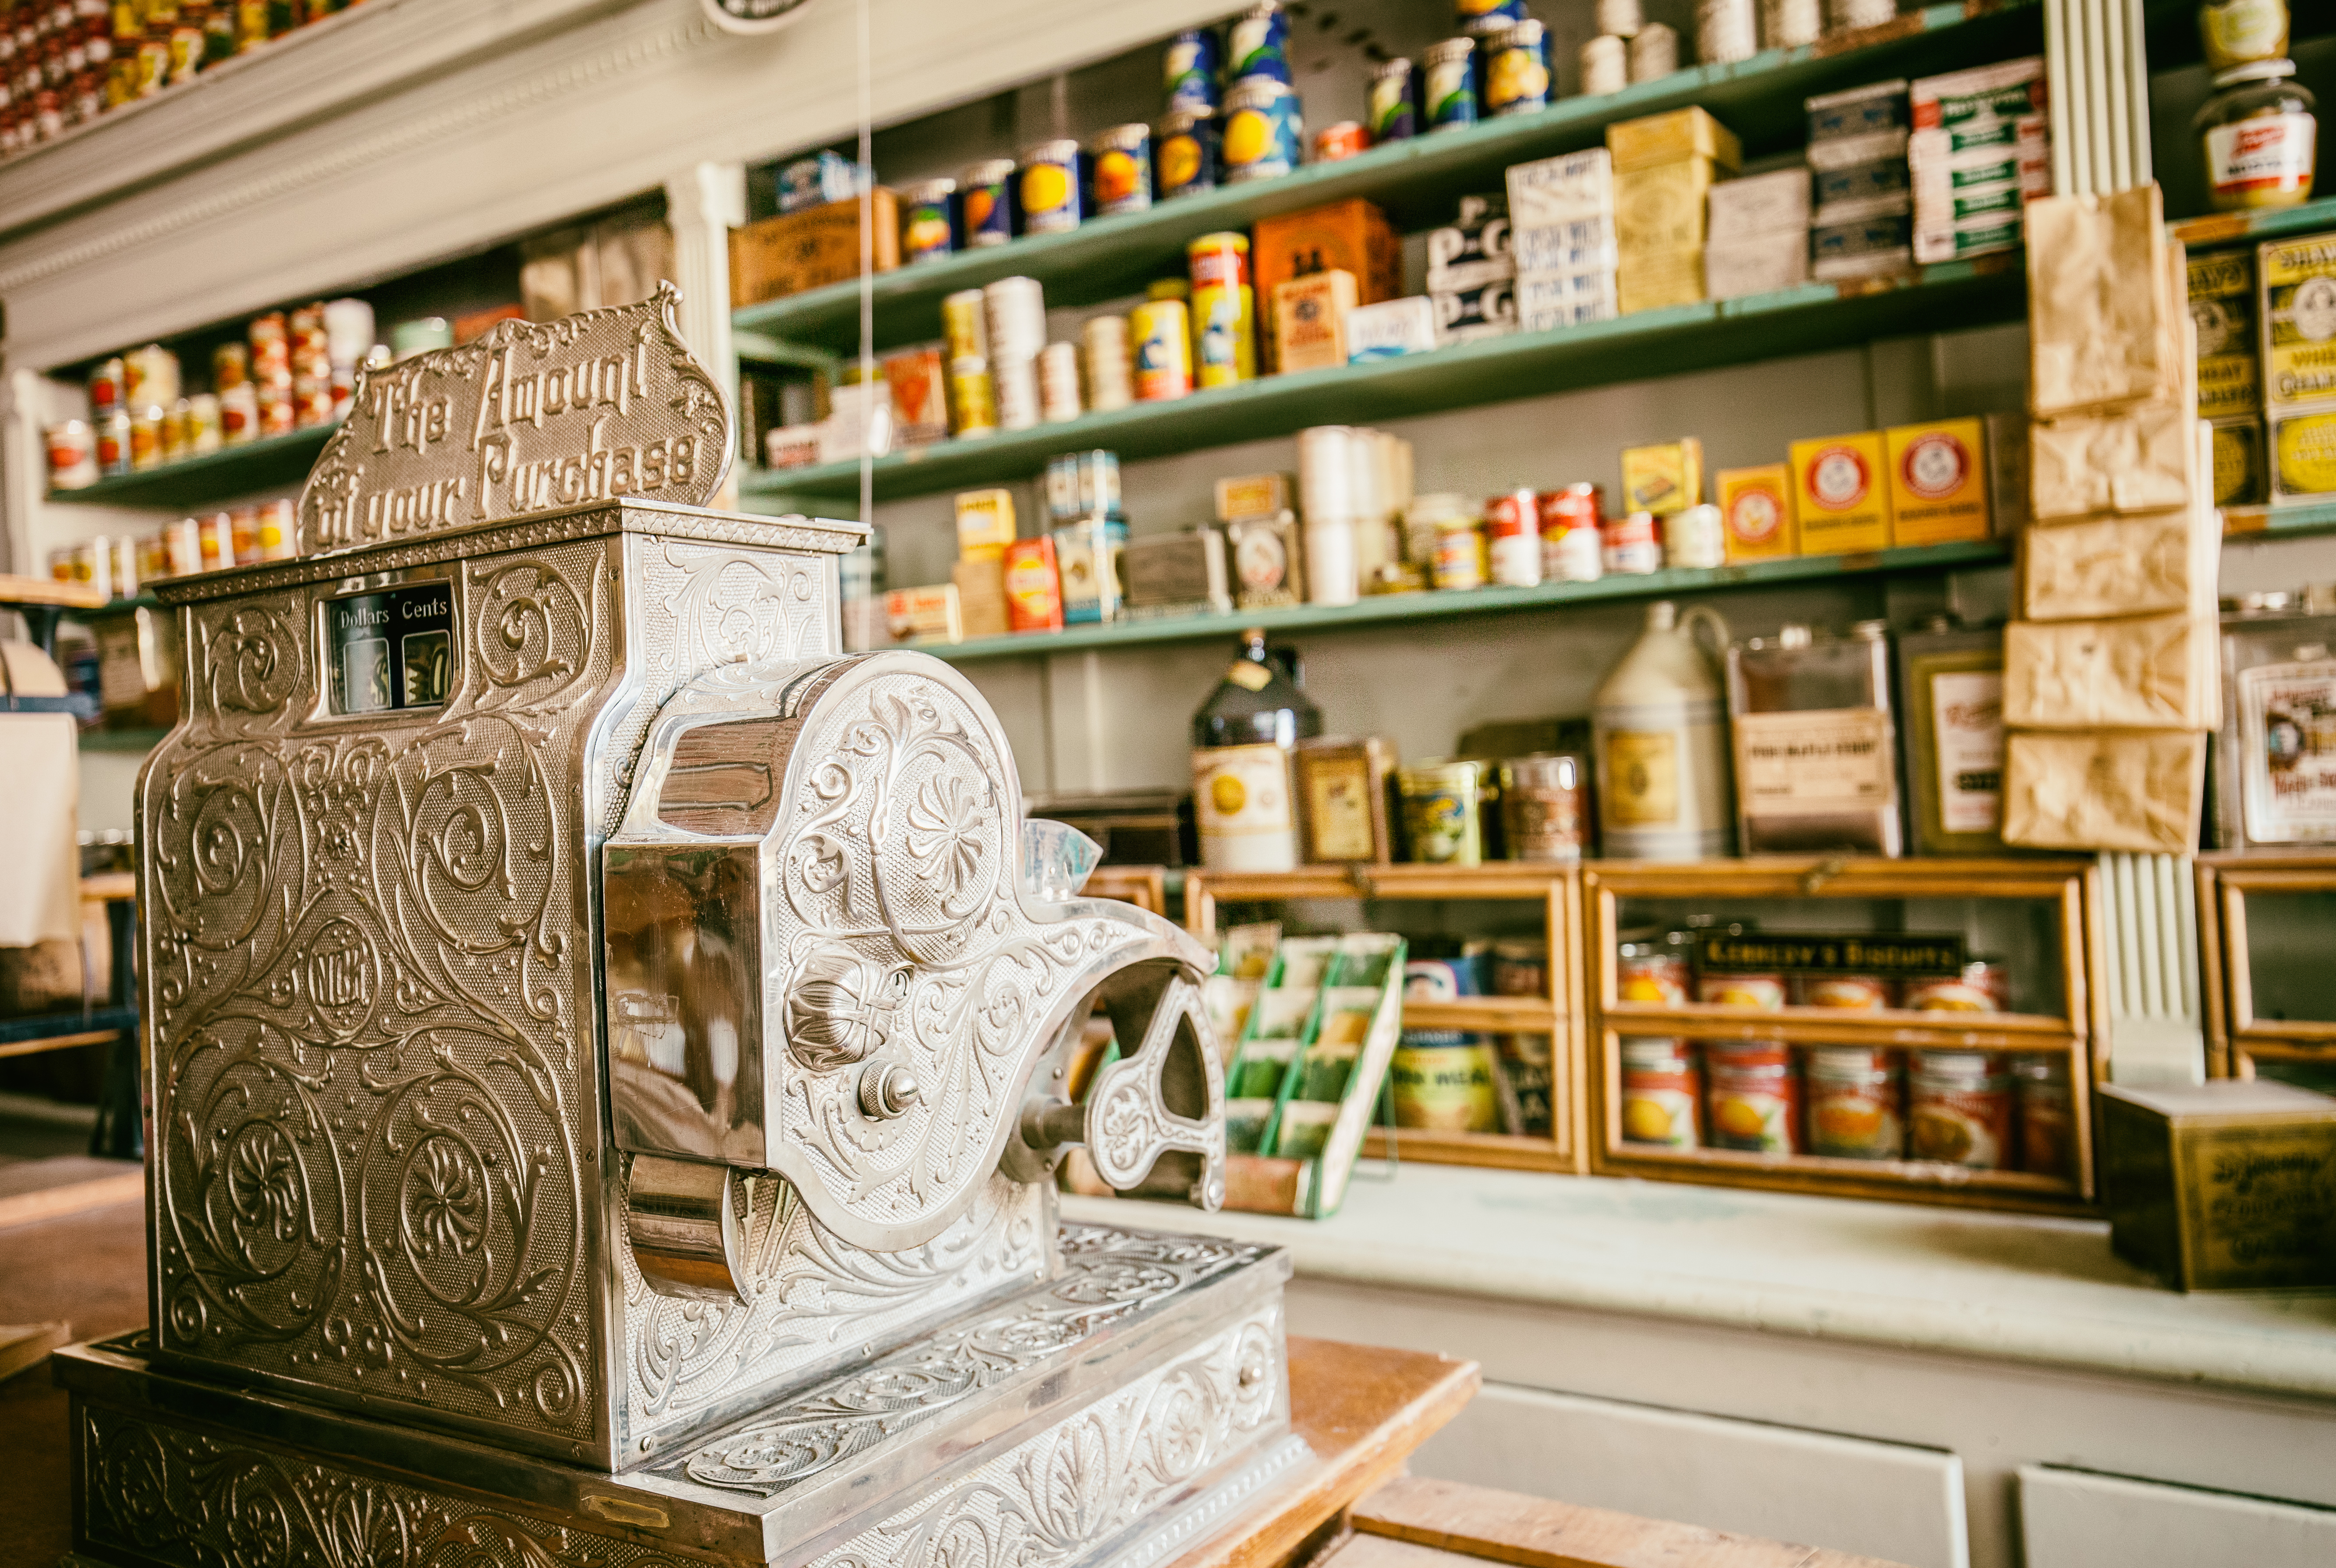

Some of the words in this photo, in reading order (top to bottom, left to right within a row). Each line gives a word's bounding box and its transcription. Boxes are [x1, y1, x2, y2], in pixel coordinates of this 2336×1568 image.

[368, 370, 452, 456] The
[470, 322, 652, 450] Amount
[475, 414, 698, 519] Purchase
[340, 607, 390, 629] Dollars
[402, 597, 447, 620] Cents
